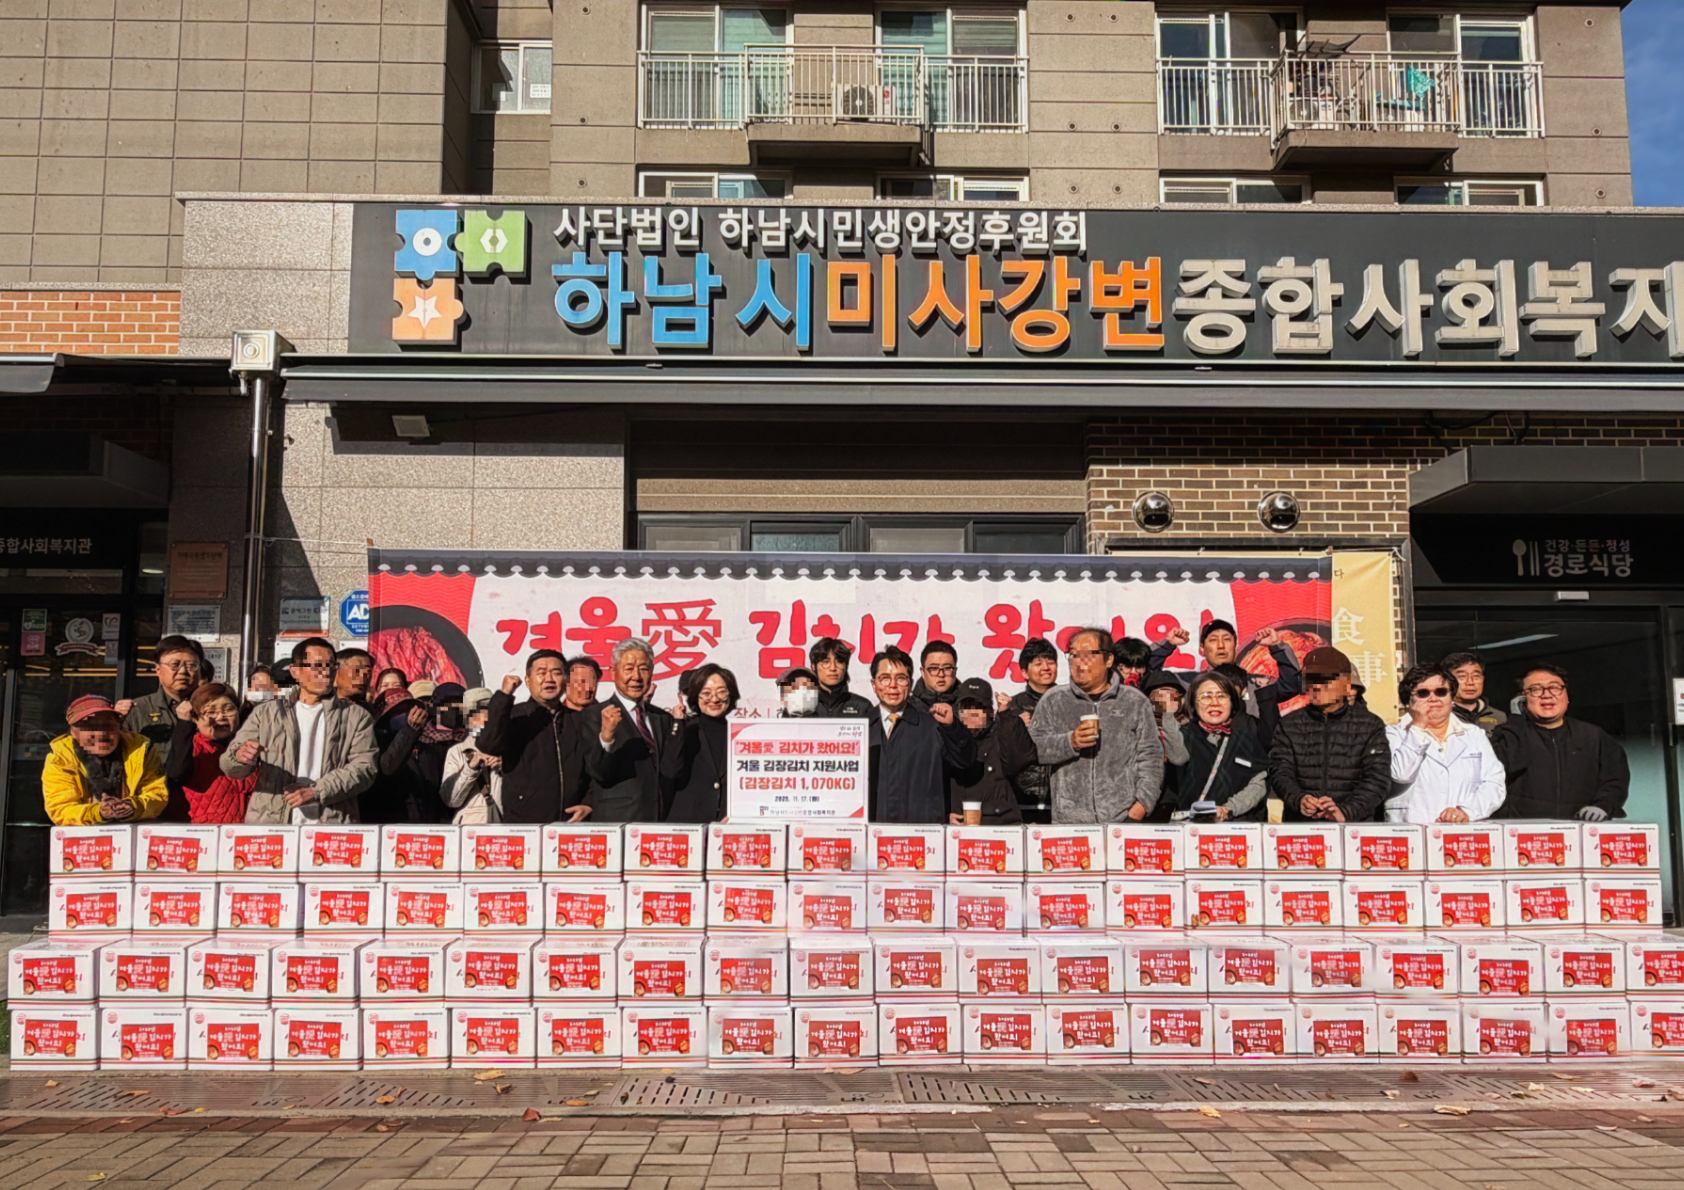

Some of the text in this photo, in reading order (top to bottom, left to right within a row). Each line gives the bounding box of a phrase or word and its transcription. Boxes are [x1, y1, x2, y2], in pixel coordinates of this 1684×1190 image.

[553, 205, 1089, 257] 사단법인 하남시민생안정후원회
[1544, 553, 1635, 578] 경로식당
[779, 741, 814, 754] 김치가
[736, 760, 860, 773] 겨울 김장김치 지원사업
[739, 776, 856, 791] (김장김치 1,070KG)
